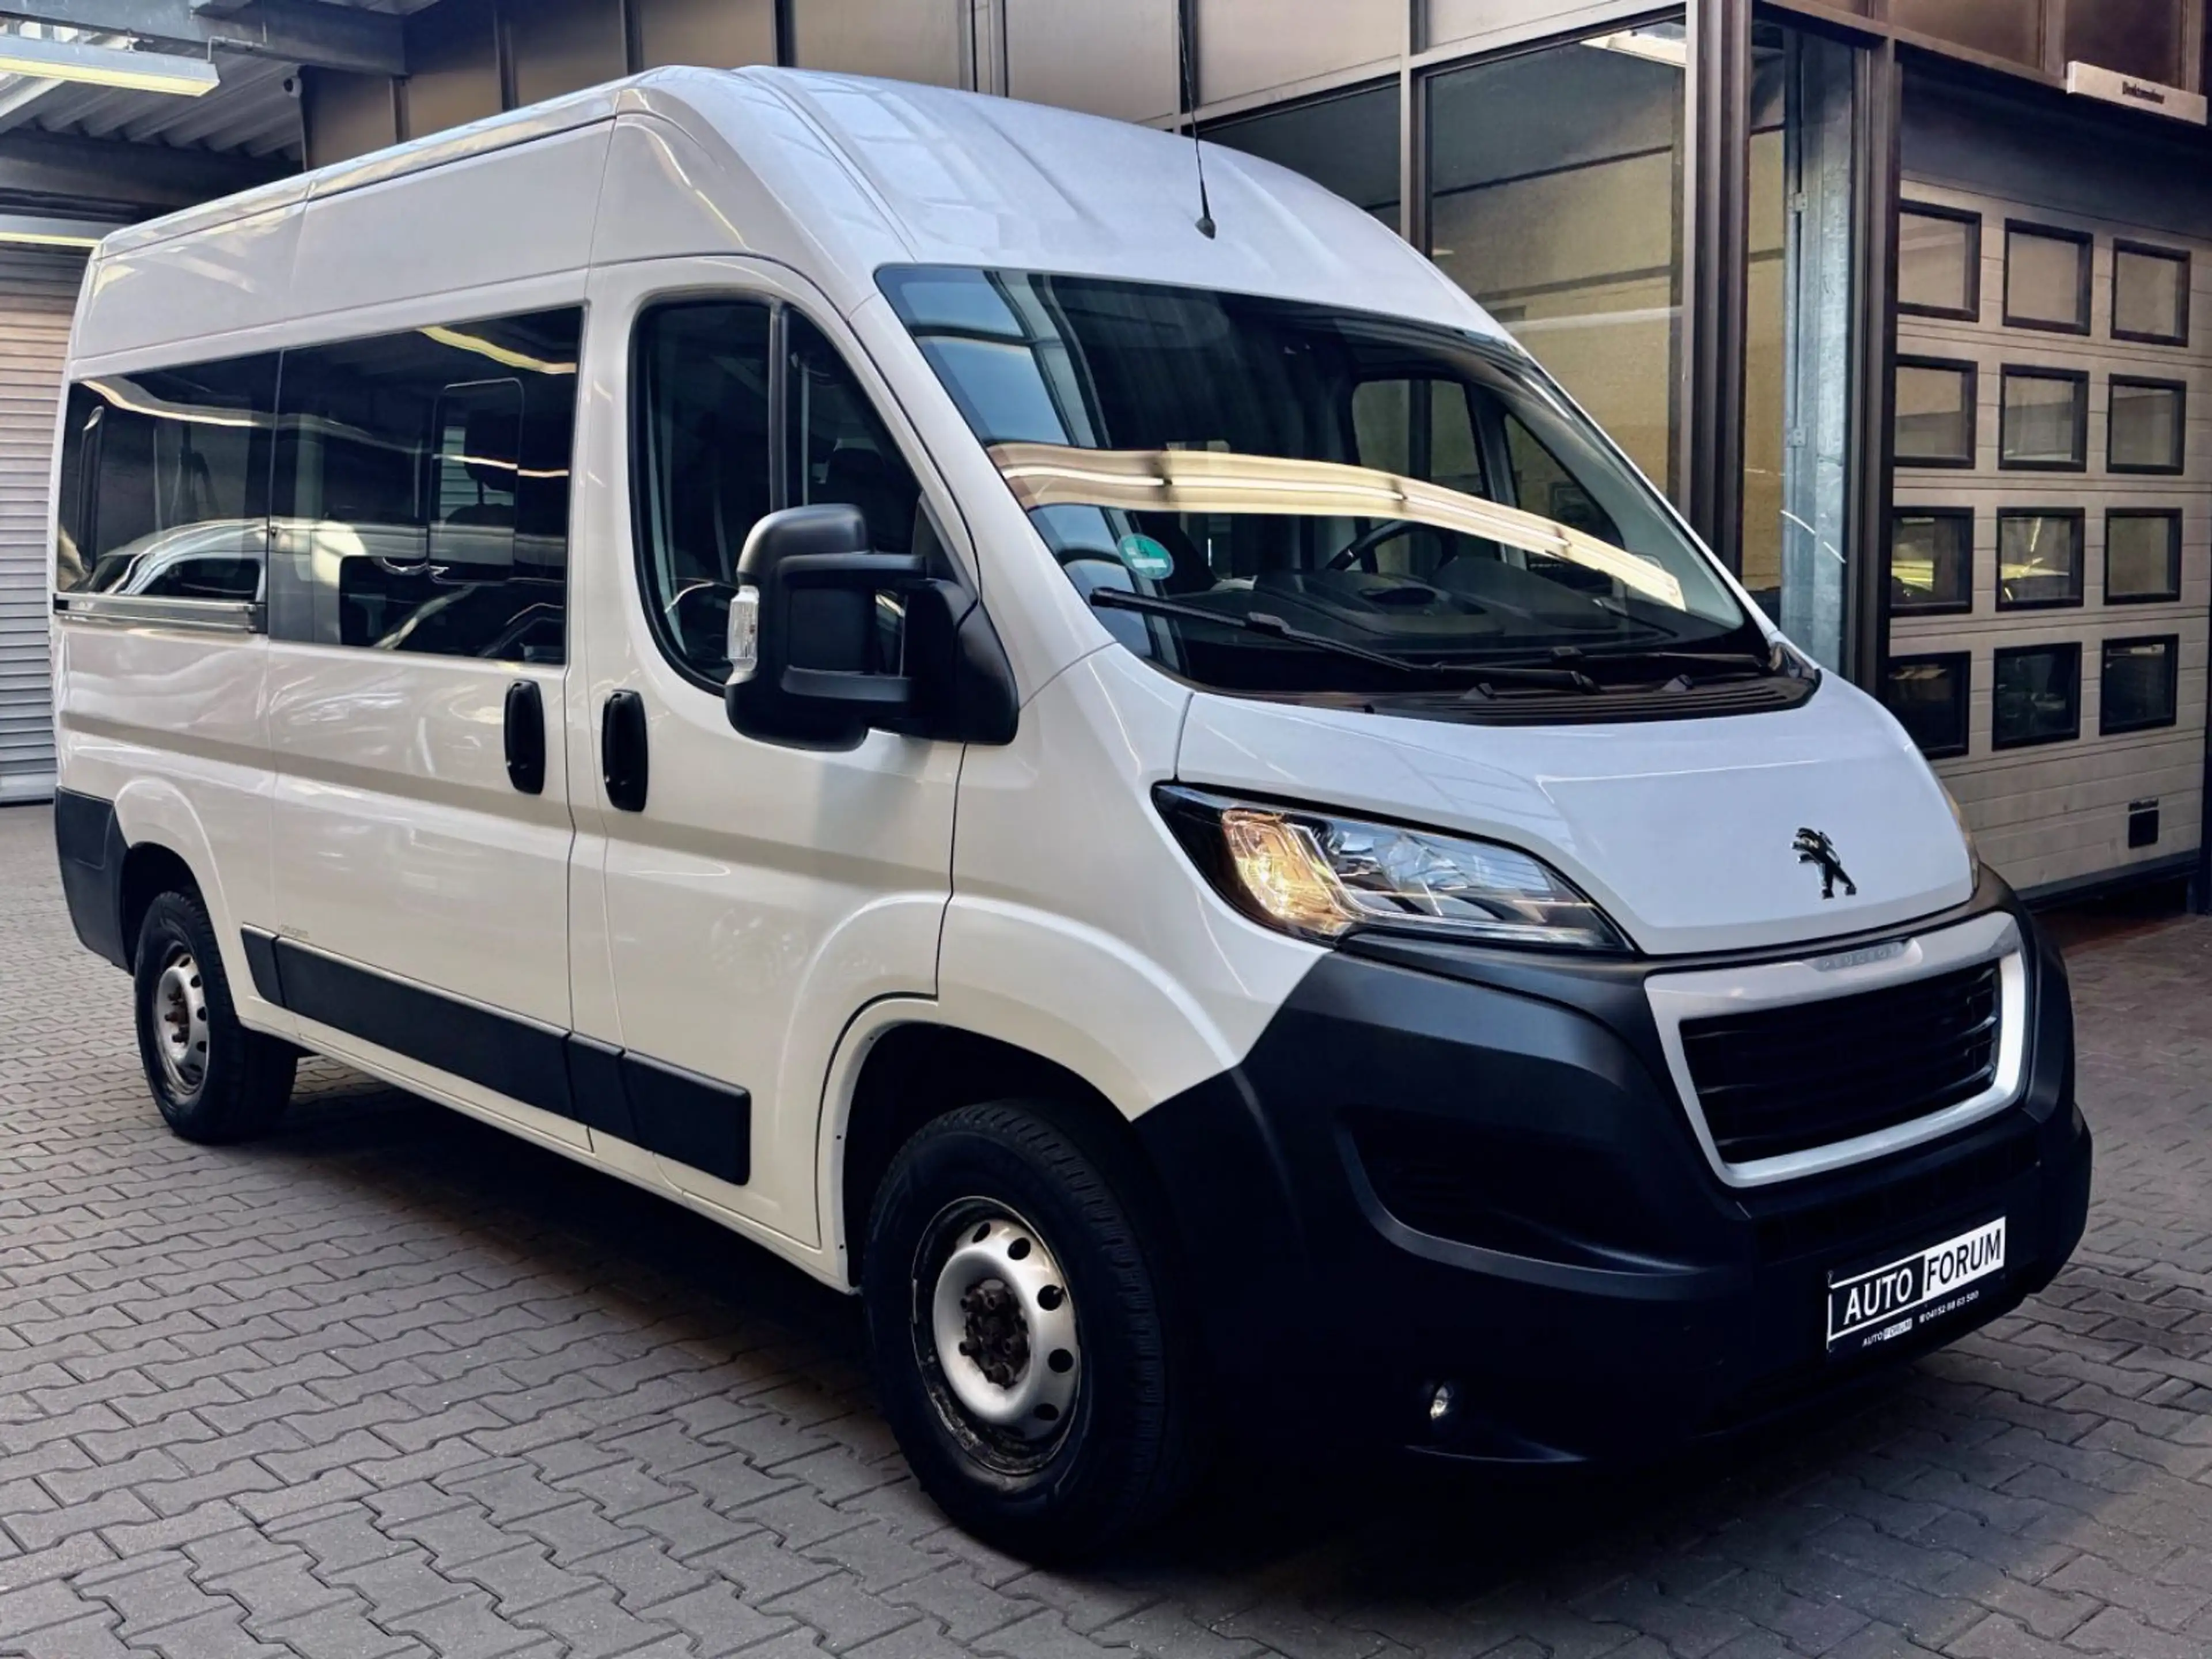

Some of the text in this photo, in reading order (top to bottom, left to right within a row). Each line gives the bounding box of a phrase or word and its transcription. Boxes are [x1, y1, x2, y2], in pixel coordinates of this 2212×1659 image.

[1843, 1228, 2001, 1325] AUTO FORUM
[1862, 1330, 1883, 1348] AUTO
